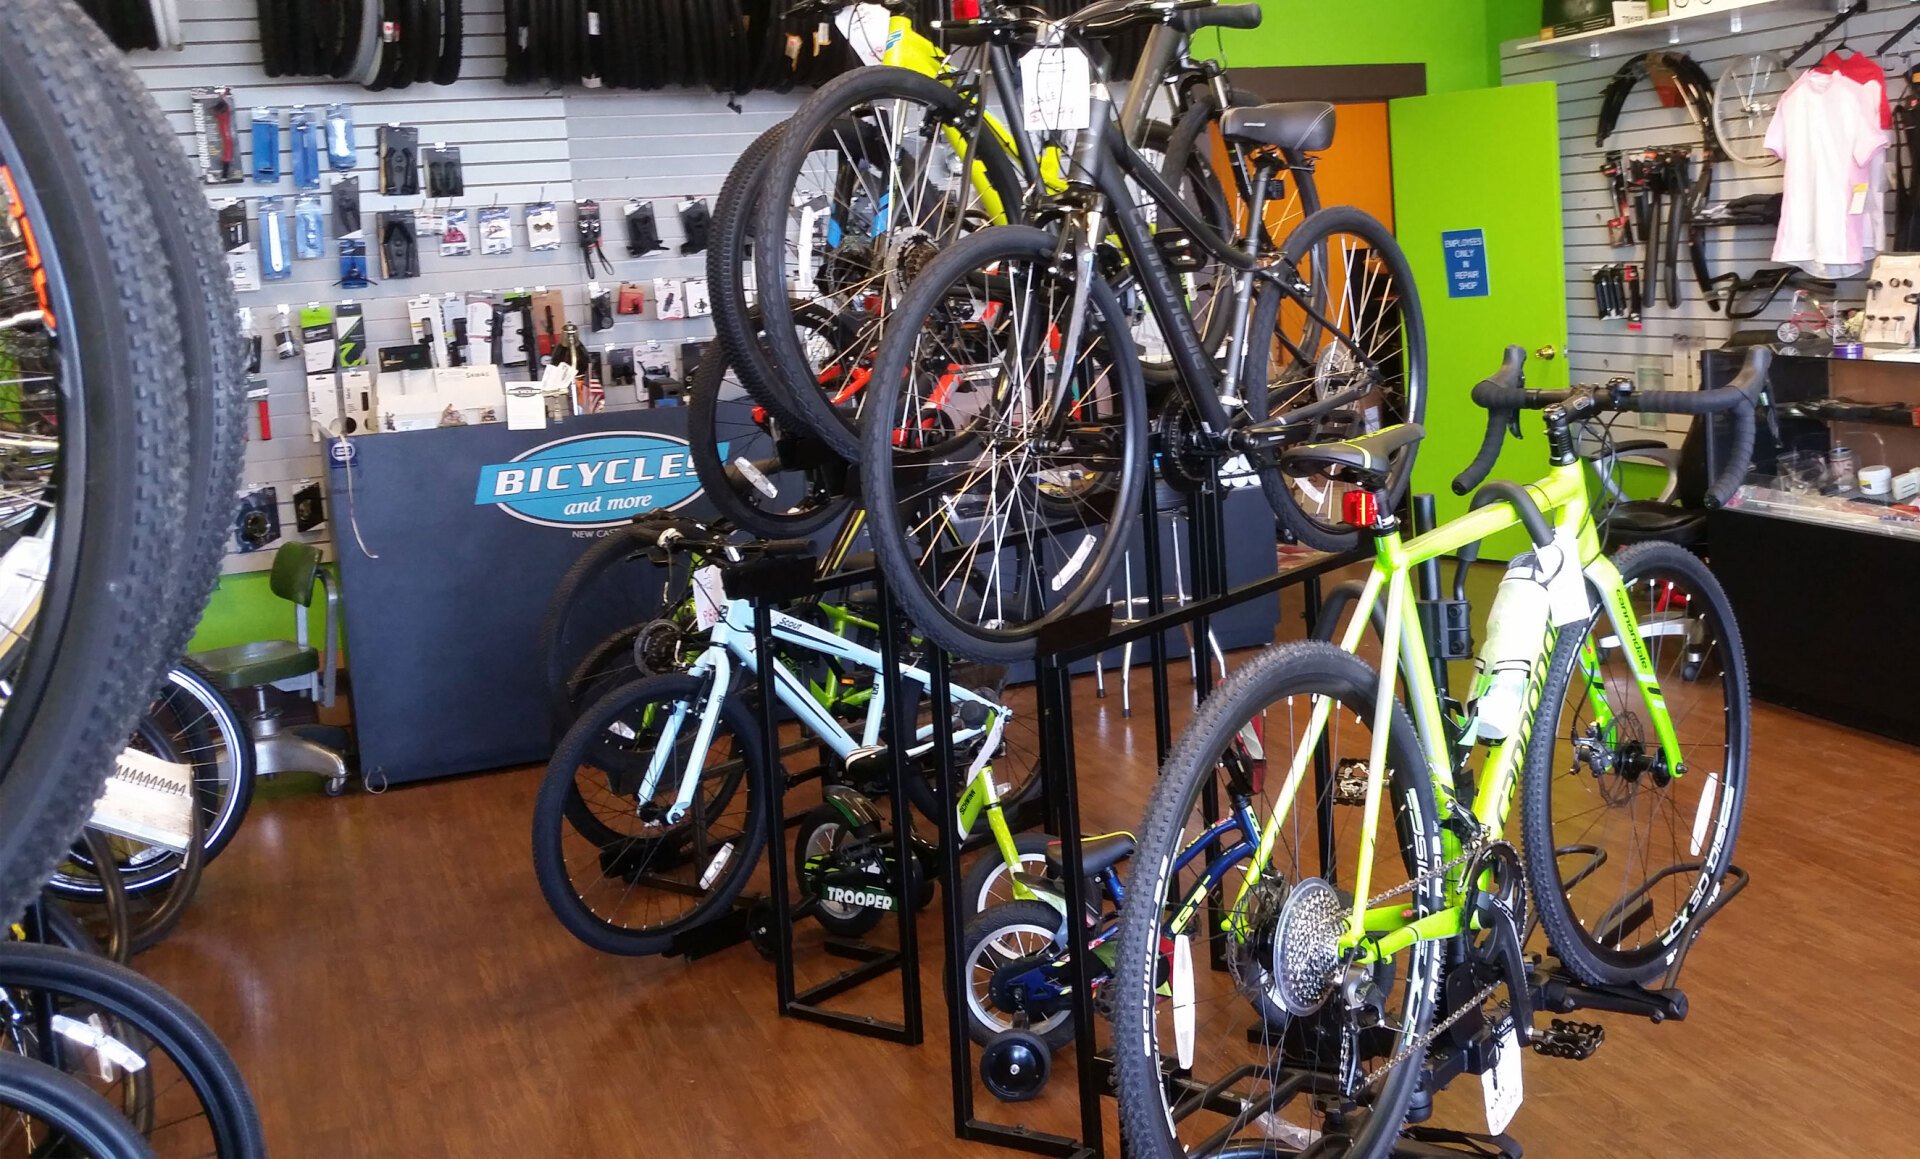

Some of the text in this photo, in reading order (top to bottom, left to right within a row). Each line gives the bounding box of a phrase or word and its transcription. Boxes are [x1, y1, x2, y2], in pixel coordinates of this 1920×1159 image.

[192, 103, 206, 133] BRUSH
[1444, 237, 1483, 248] EMPLOYEES
[1454, 249, 1475, 258] ONLY
[1462, 260, 1470, 268] IN
[1455, 270, 1479, 280] REPAIR
[1129, 207, 1206, 371] cannondale
[1458, 281, 1478, 290] SHOP
[564, 494, 653, 516] and more
[571, 530, 595, 539] NEW
[778, 617, 803, 631] Scout
[1616, 588, 1648, 670] cannondale
[959, 788, 977, 816] SCHWINN
[827, 886, 893, 911] TROOPER
[1171, 874, 1212, 935] GT
